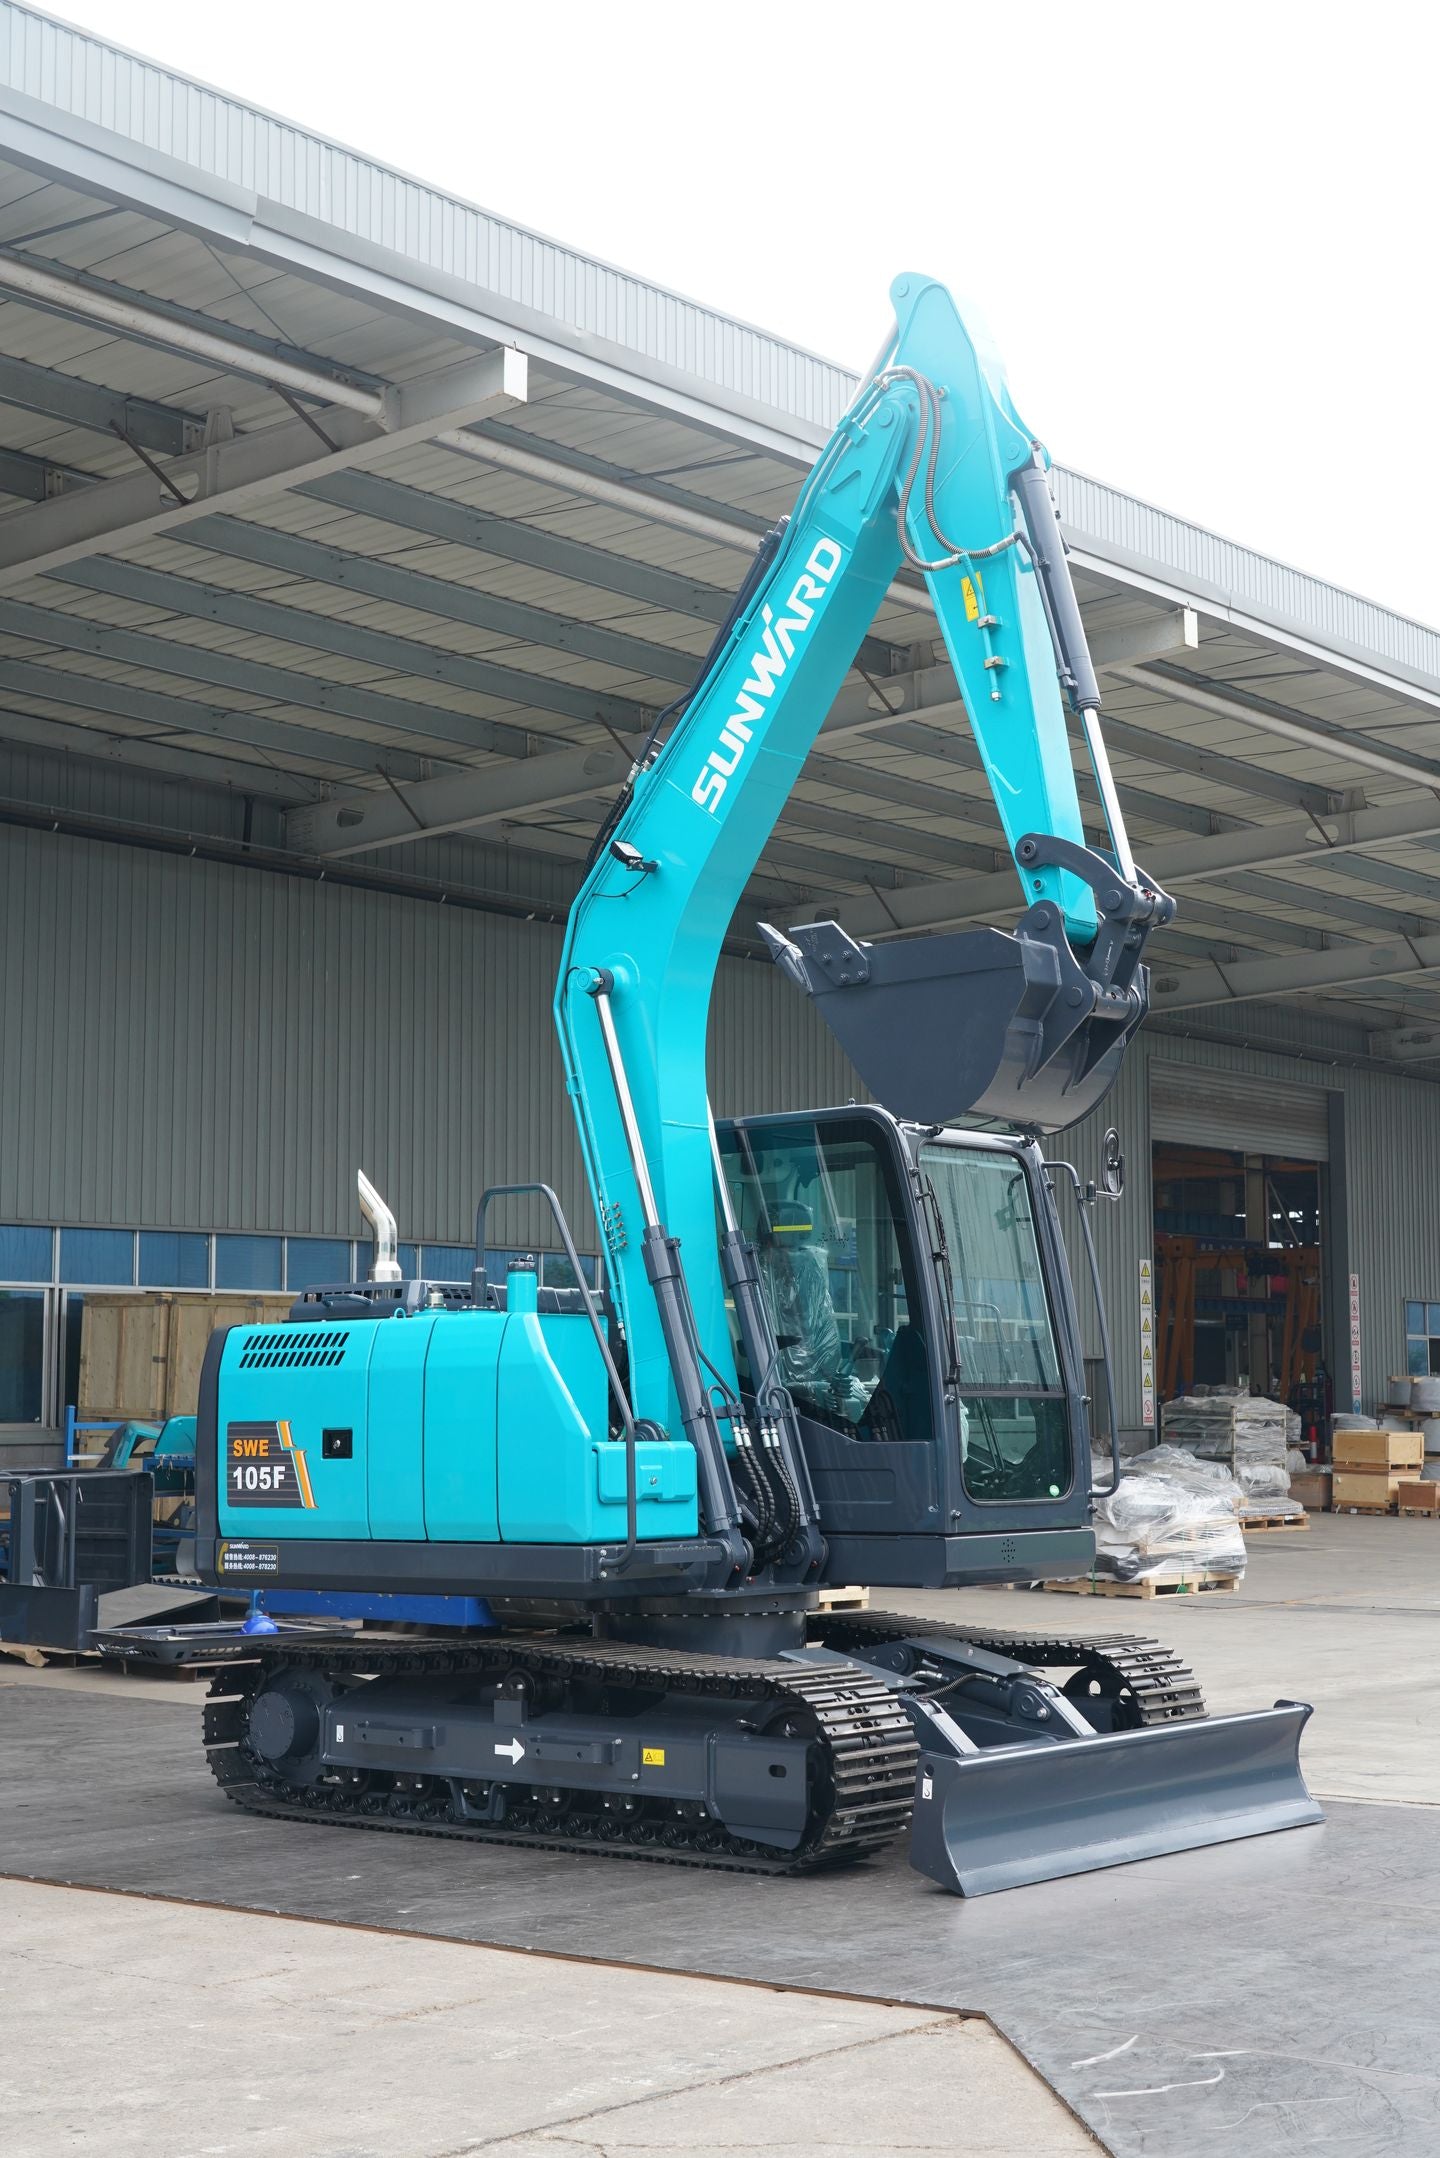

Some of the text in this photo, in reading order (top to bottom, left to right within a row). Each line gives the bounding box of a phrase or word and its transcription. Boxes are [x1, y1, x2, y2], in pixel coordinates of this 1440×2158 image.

[692, 537, 842, 814] SUNWARD
[233, 1439, 269, 1457] SWE
[233, 1466, 286, 1490] 105F
